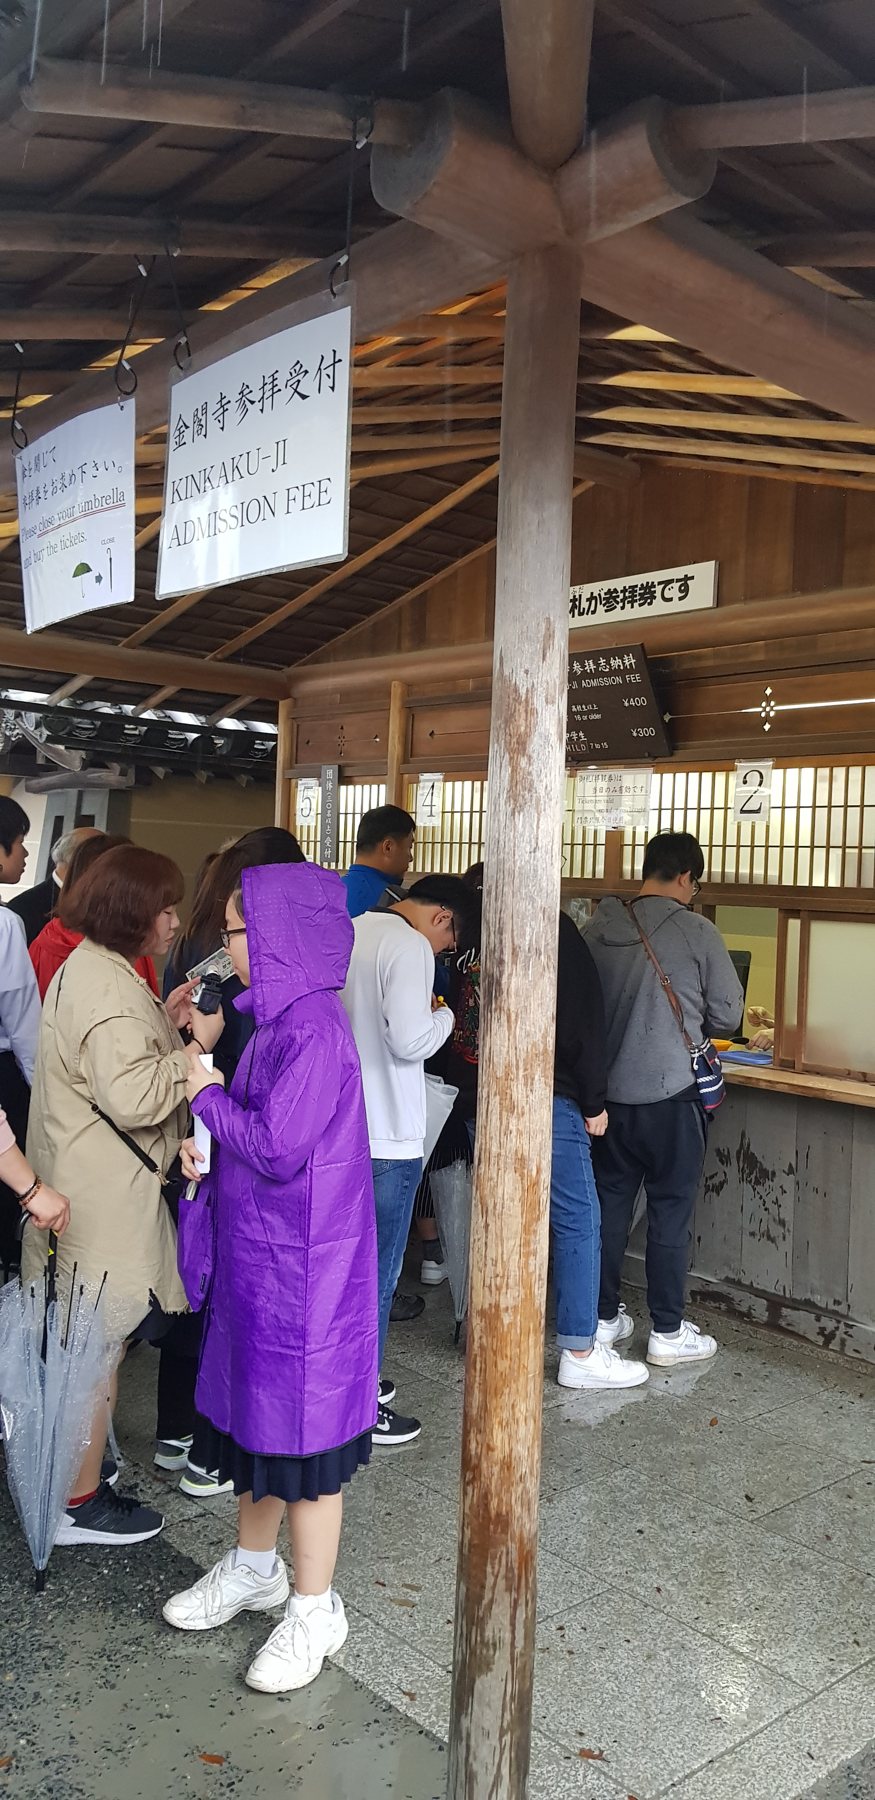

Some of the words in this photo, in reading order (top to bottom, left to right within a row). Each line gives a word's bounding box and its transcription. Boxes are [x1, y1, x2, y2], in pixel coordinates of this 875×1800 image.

[172, 349, 343, 452] 金閣寺参拝受付
[170, 438, 288, 505] KINKAKU-JI
[38, 514, 55, 532] close
[56, 505, 75, 523] your
[78, 487, 125, 514] umbrella
[168, 491, 278, 549] ADMISSION
[284, 477, 332, 515] FEE
[33, 547, 45, 563] buy
[46, 540, 58, 556] the
[569, 574, 695, 618] 札が参拝券です
[567, 653, 637, 676] 参拝志納料
[581, 676, 623, 689] ADMISSION
[626, 673, 642, 684] FEE
[622, 696, 647, 707] ¥400
[630, 727, 656, 737] ¥300
[300, 786, 314, 818] 5
[421, 780, 437, 818] 4
[739, 769, 764, 815] 2
